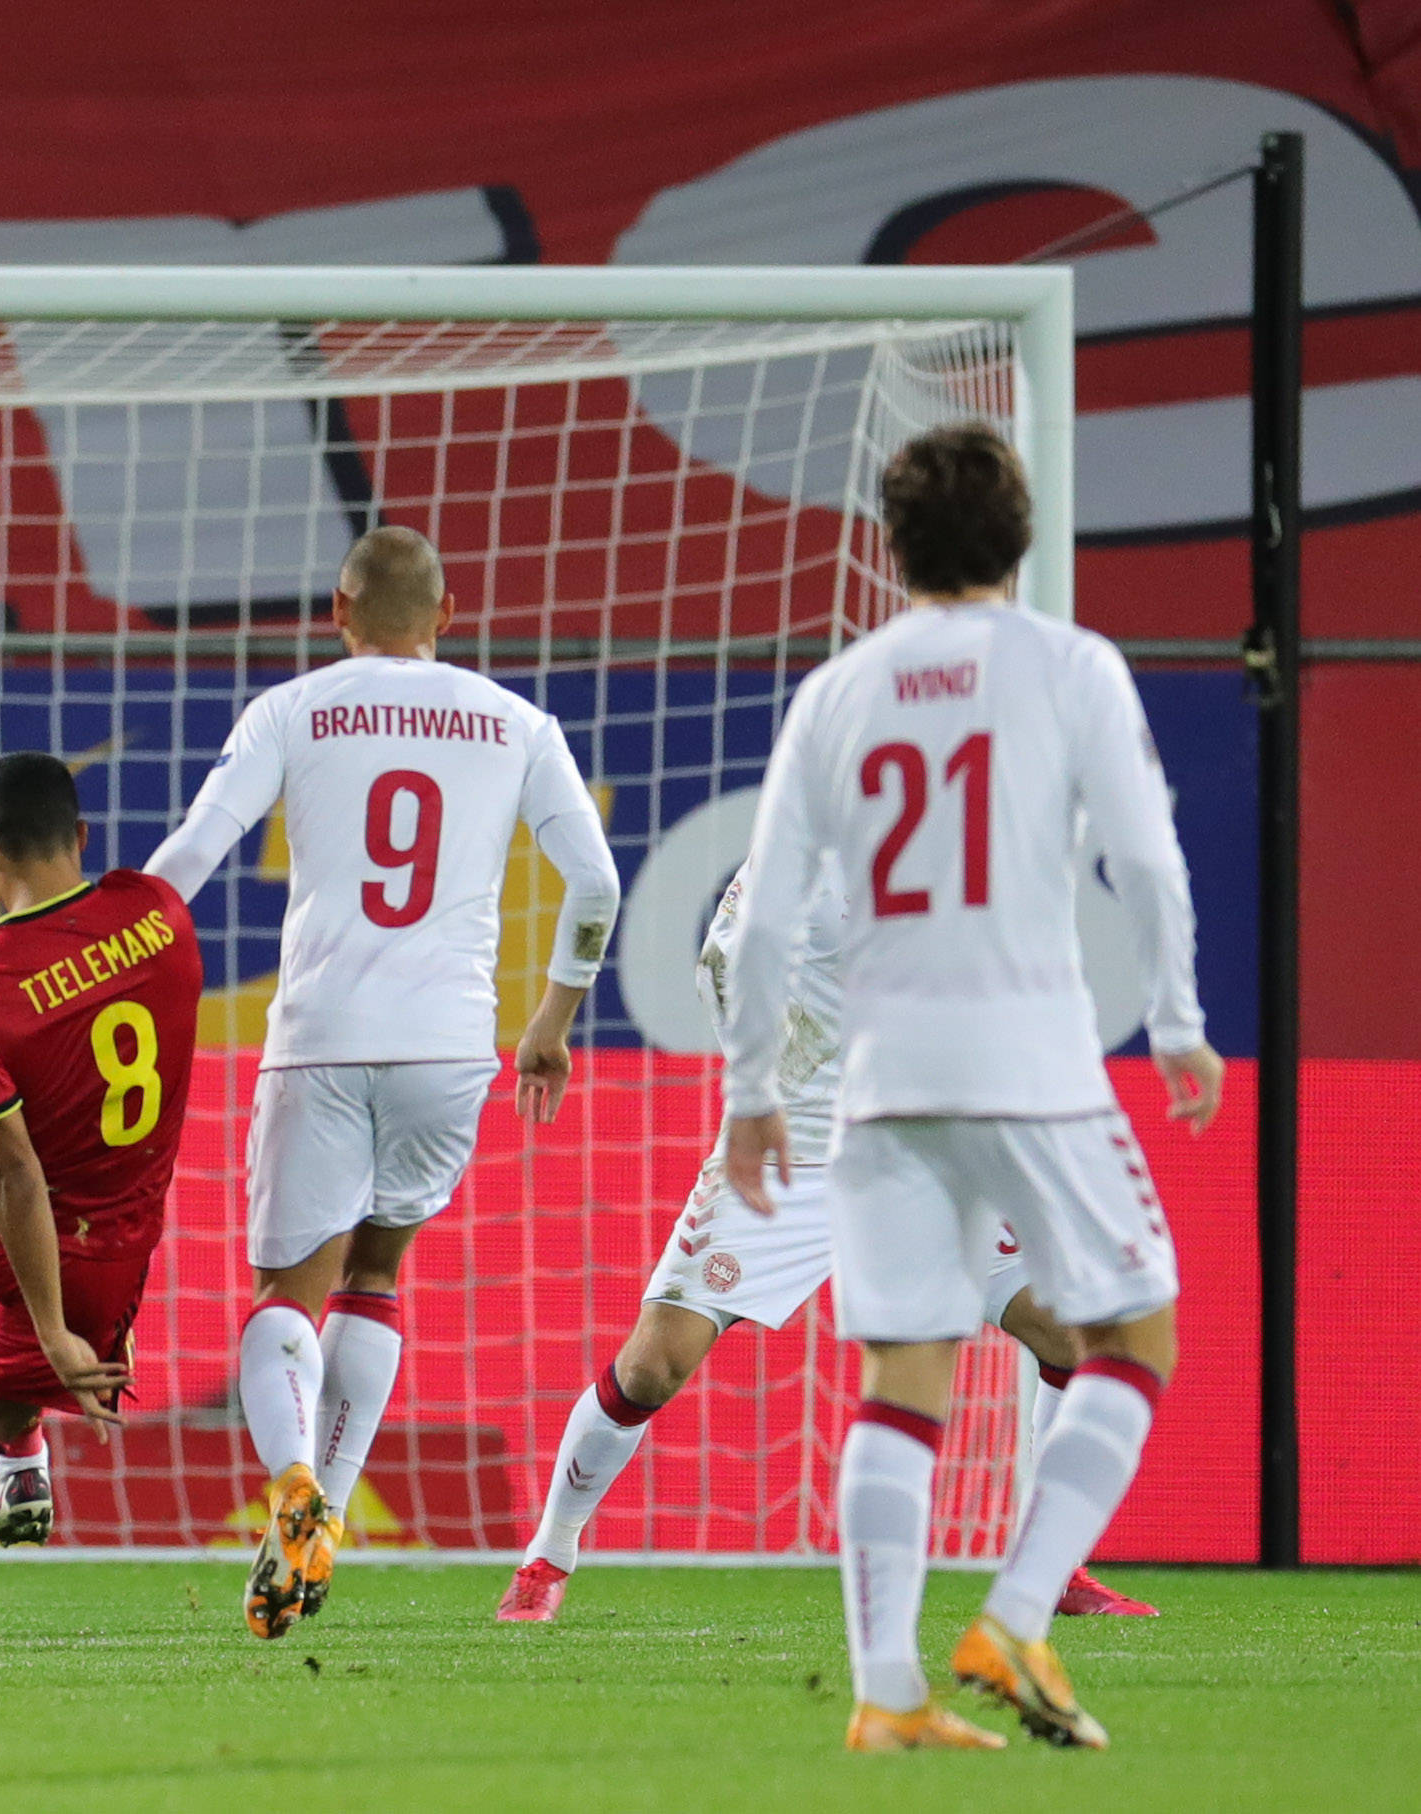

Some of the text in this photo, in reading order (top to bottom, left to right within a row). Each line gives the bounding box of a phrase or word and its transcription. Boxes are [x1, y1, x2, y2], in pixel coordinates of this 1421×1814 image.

[311, 704, 508, 746] BRAITHWAITE
[361, 769, 444, 929] 9
[860, 731, 993, 920] 21
[19, 909, 175, 1015] TIELEMANS
[90, 1001, 162, 1147] 8
[710, 1262, 735, 1283] DBU
